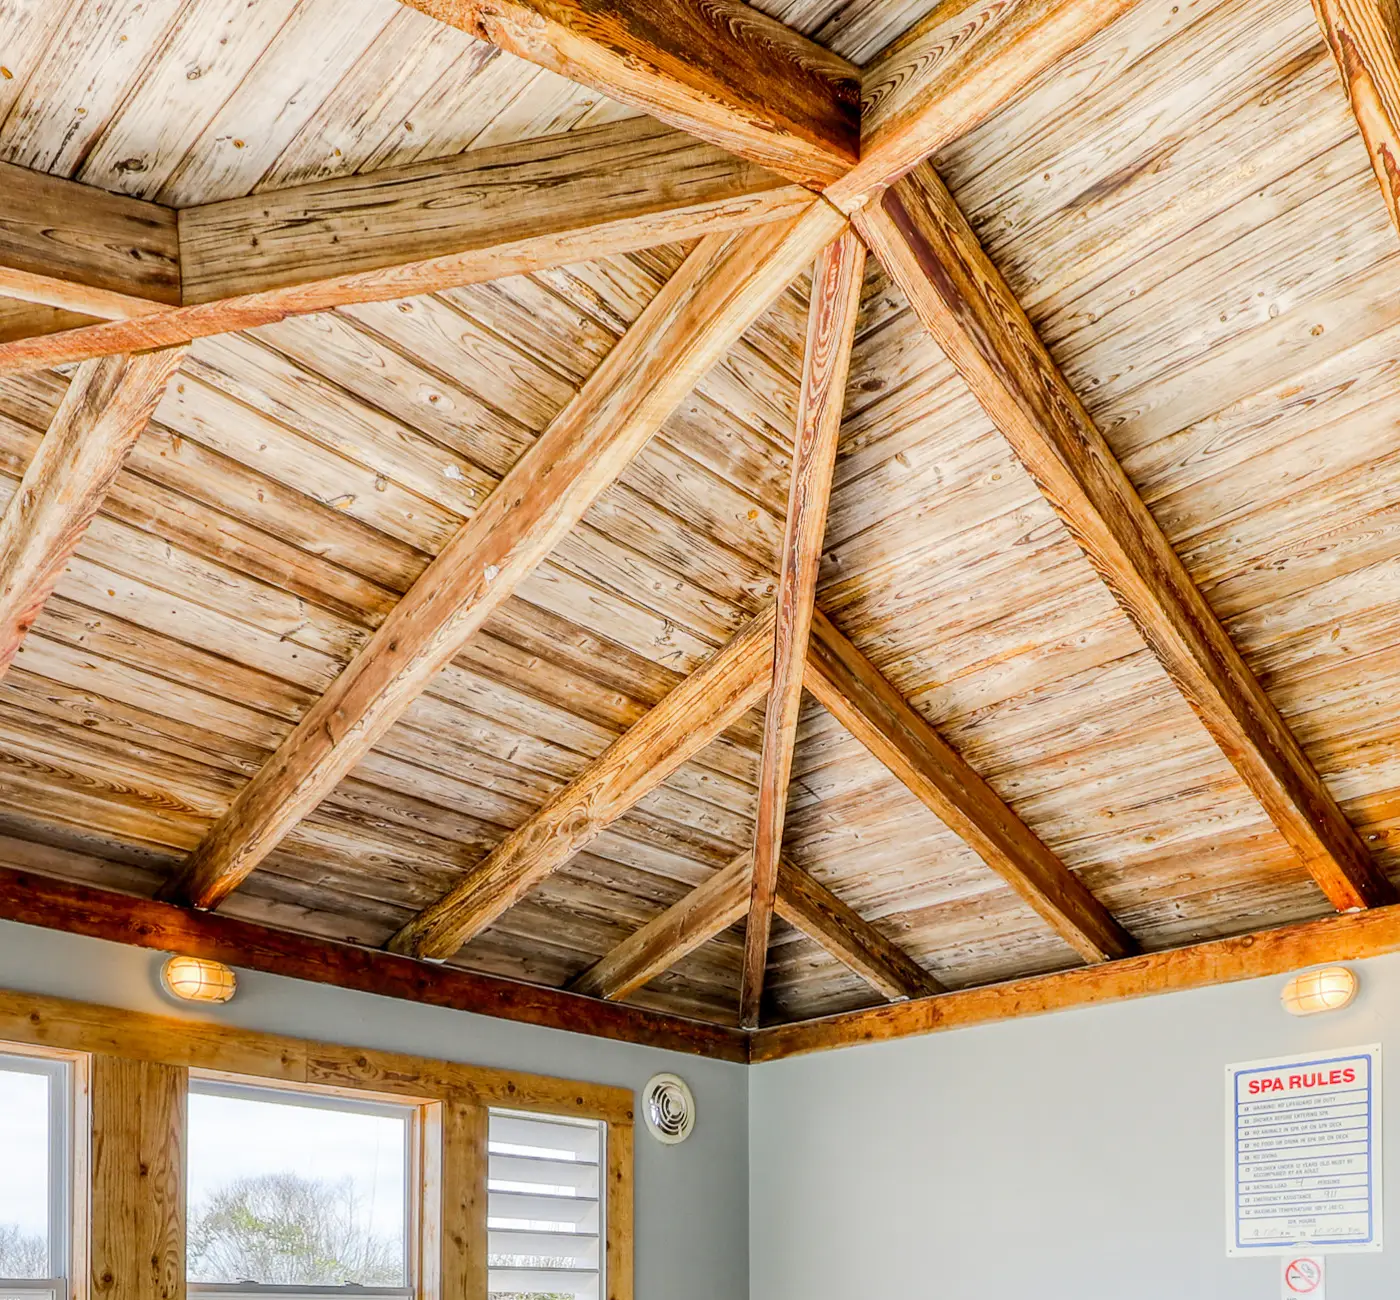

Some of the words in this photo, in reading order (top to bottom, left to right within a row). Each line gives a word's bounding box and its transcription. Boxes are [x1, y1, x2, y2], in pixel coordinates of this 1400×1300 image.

[1248, 1077, 1284, 1094] SPA
[1289, 1068, 1356, 1089] RULES
[1294, 1111, 1317, 1119] ENTERING
